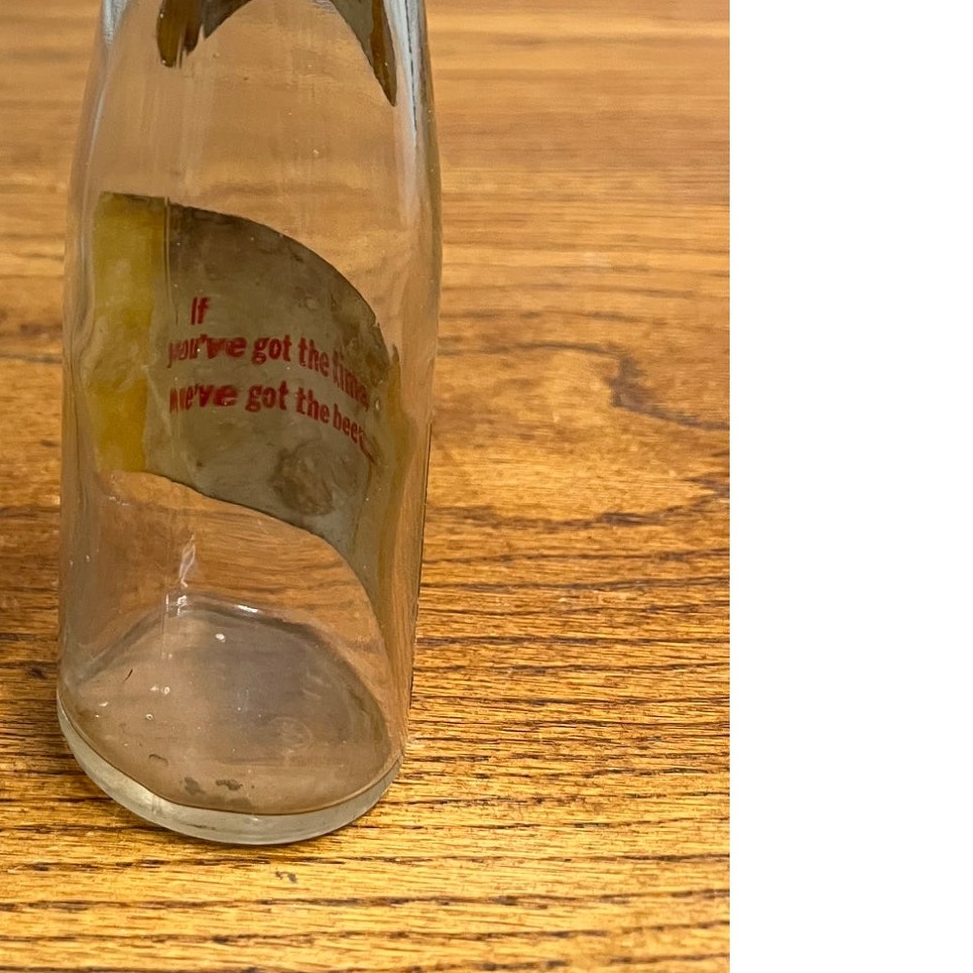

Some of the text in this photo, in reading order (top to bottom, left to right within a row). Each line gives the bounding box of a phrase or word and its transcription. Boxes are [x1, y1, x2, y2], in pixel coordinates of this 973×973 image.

[191, 297, 211, 325] If
[167, 334, 247, 368] you've
[251, 334, 293, 365] got
[298, 336, 330, 377] the
[169, 383, 239, 413] we've
[245, 380, 289, 413] got
[296, 386, 330, 423] the
